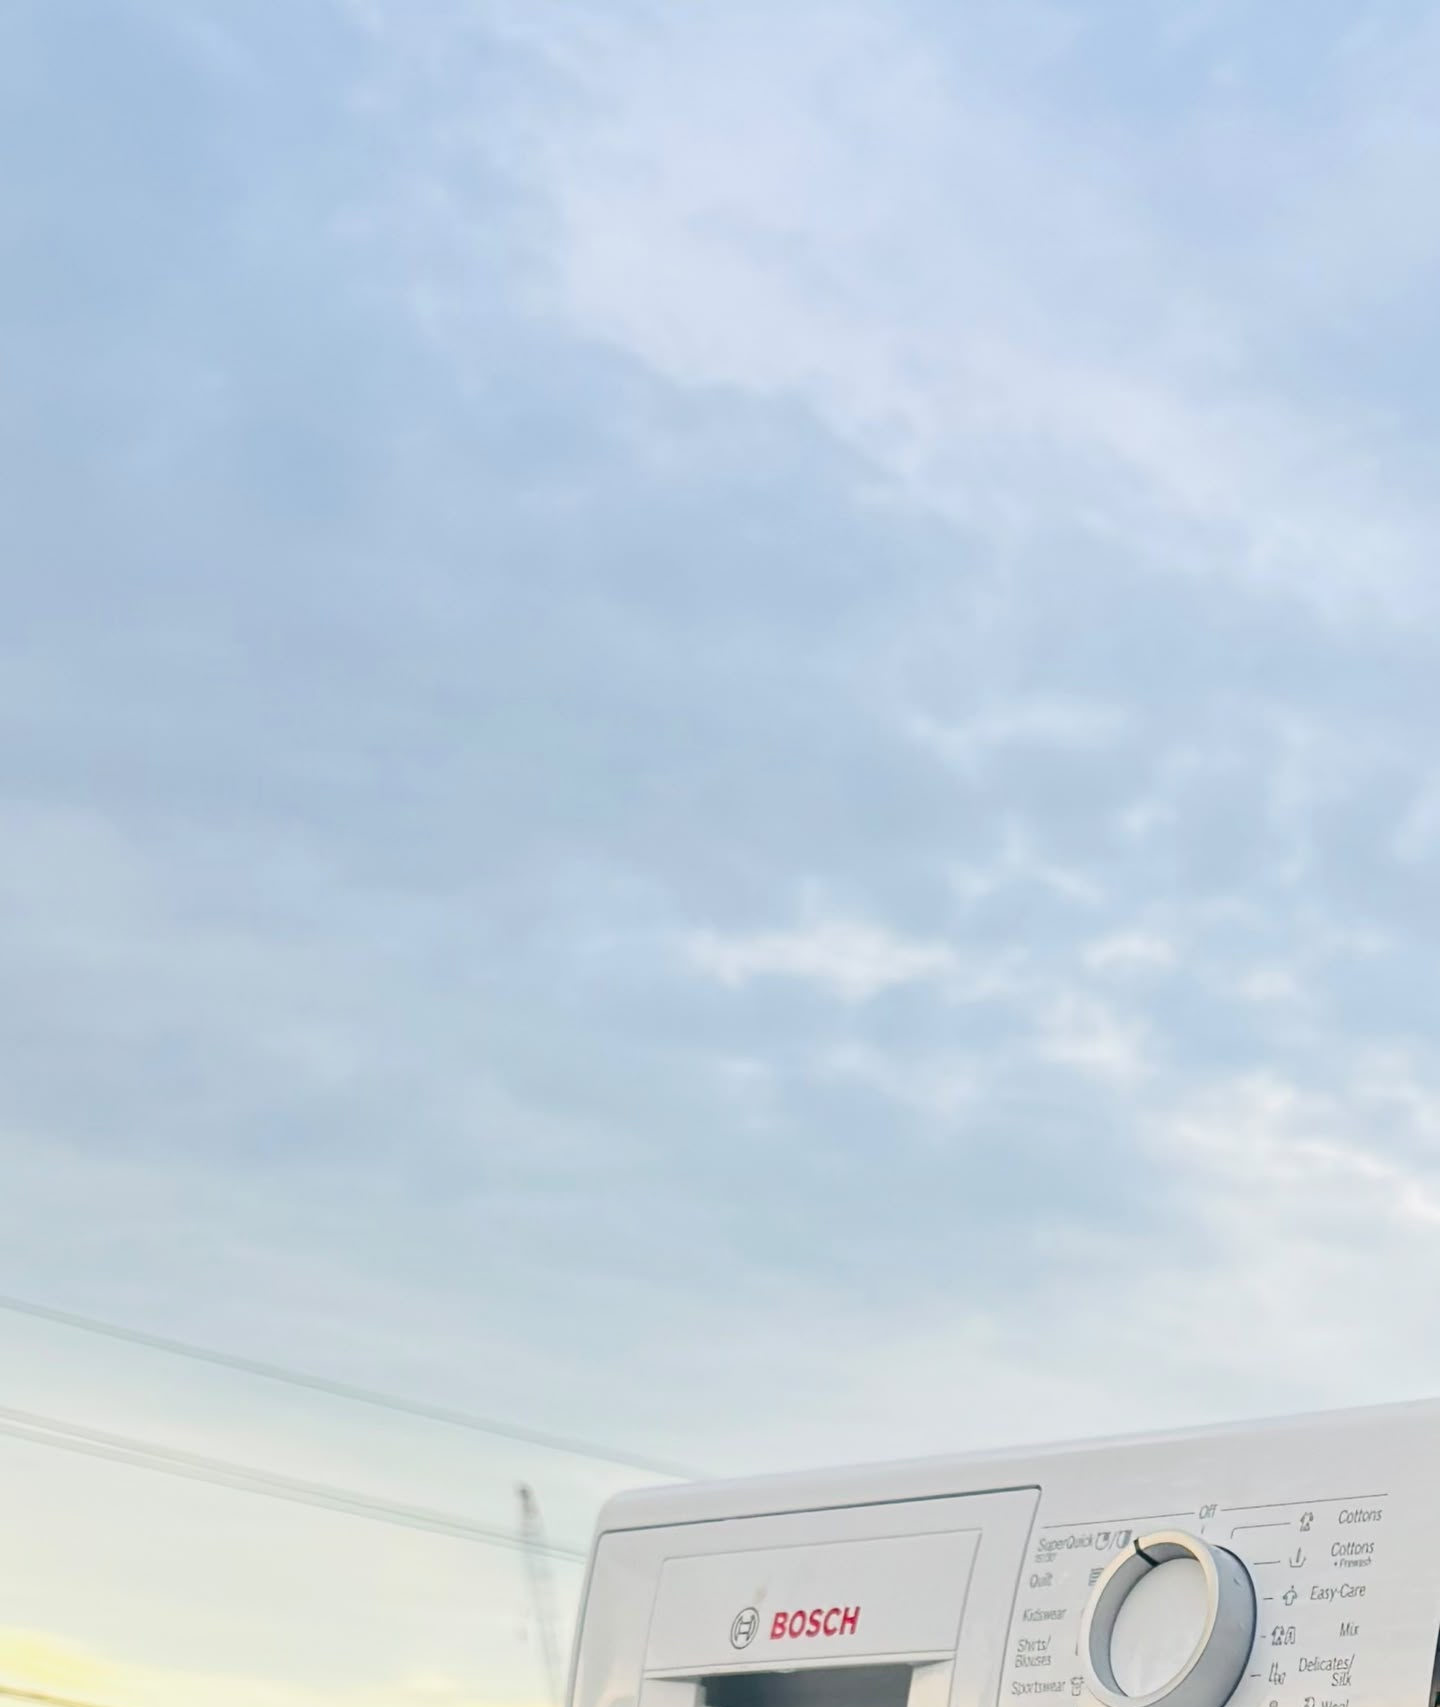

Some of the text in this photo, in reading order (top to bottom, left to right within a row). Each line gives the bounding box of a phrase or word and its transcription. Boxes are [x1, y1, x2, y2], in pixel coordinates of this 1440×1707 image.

[1199, 1503, 1218, 1519] Off
[1338, 1509, 1382, 1524] Cottons
[1038, 1535, 1093, 1552] SuperQuick
[1331, 1542, 1374, 1557] Cottons
[1310, 1583, 1366, 1602] Easy-Care
[769, 1606, 860, 1640] BOSCH
[1023, 1608, 1067, 1622] Kidswear
[1340, 1622, 1359, 1637] Mix
[1017, 1635, 1051, 1653] Shirts/
[1299, 1653, 1355, 1673] Delicates/
[1331, 1671, 1352, 1687] Silk
[1011, 1681, 1066, 1696] Sportswear
